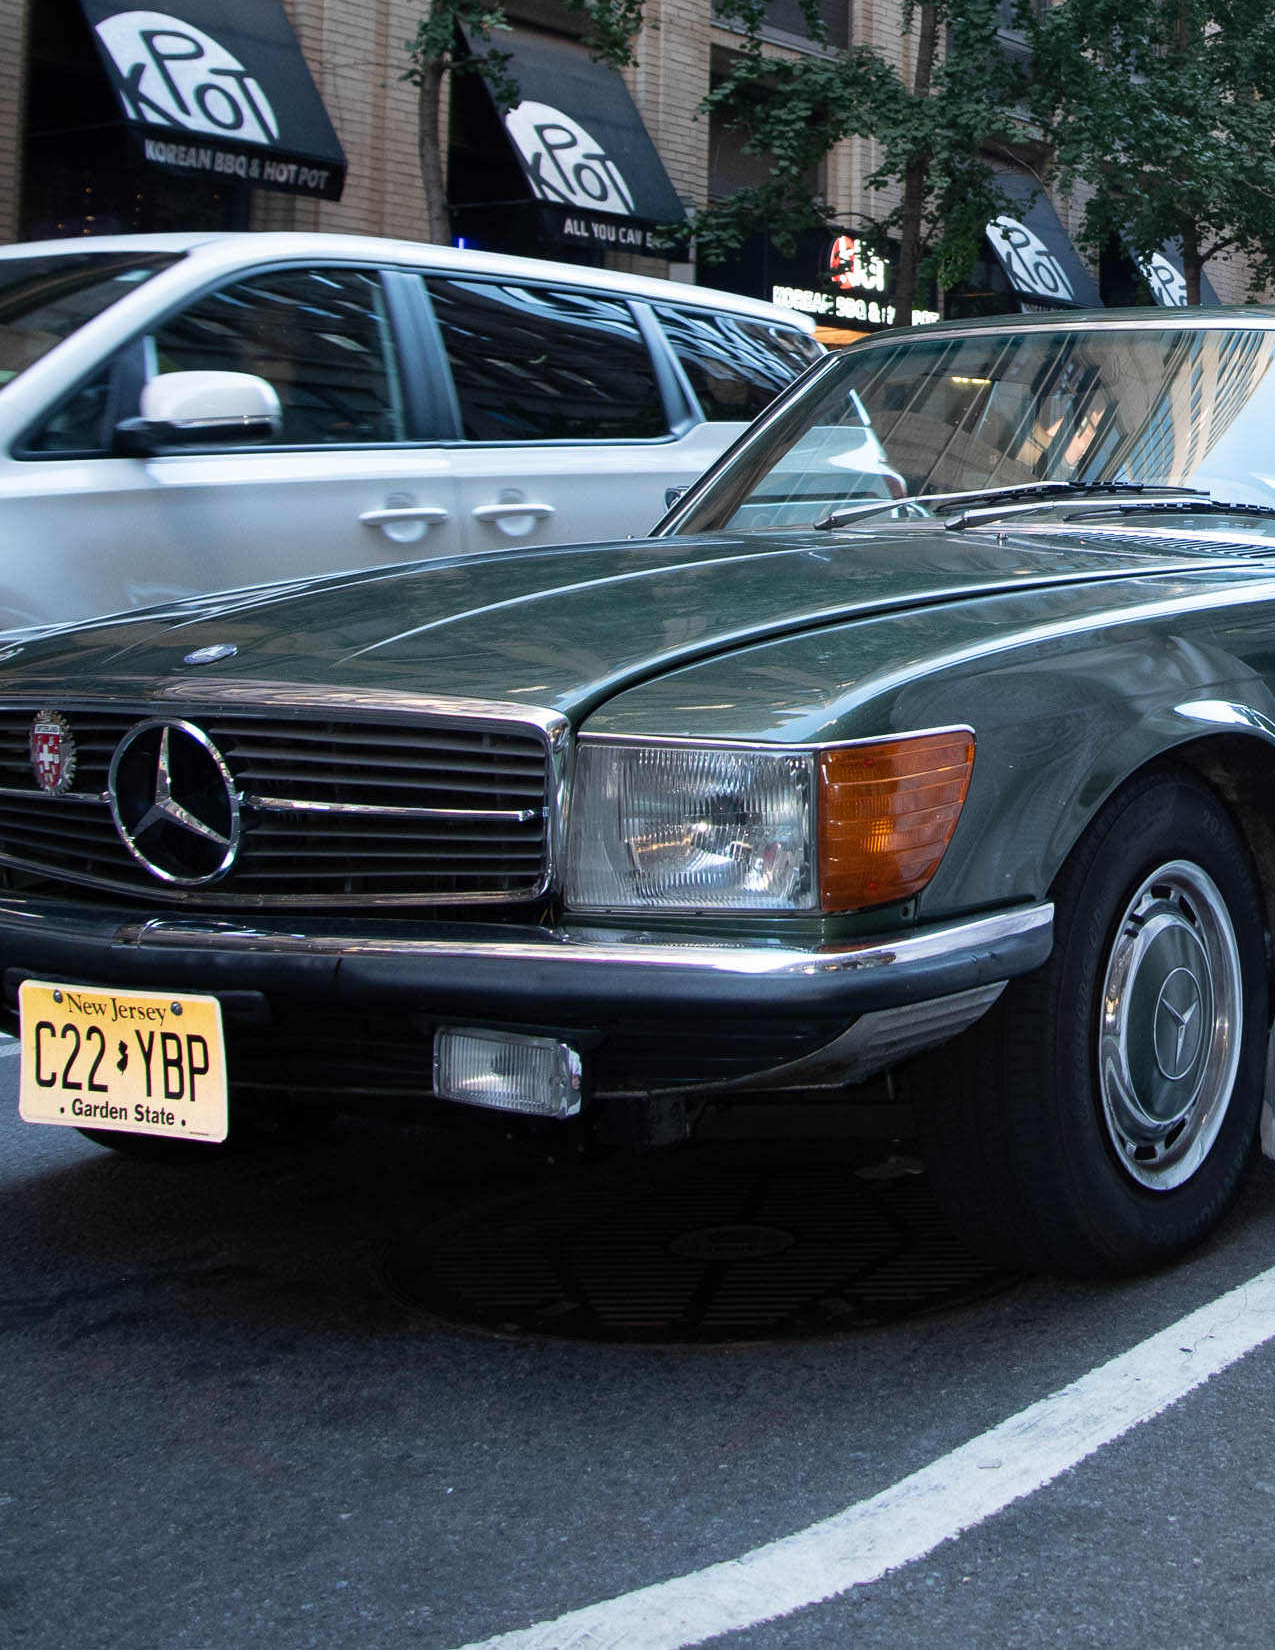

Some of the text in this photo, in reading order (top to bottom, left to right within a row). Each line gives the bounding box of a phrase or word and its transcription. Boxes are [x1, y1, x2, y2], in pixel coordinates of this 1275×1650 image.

[145, 139, 330, 190] KOREAN BBQ & HOT POT
[564, 218, 589, 236] ALL
[592, 222, 615, 242] YOU
[619, 228, 642, 246] CAN
[66, 992, 167, 1026] New Jersey
[71, 1097, 175, 1125] Garden State
